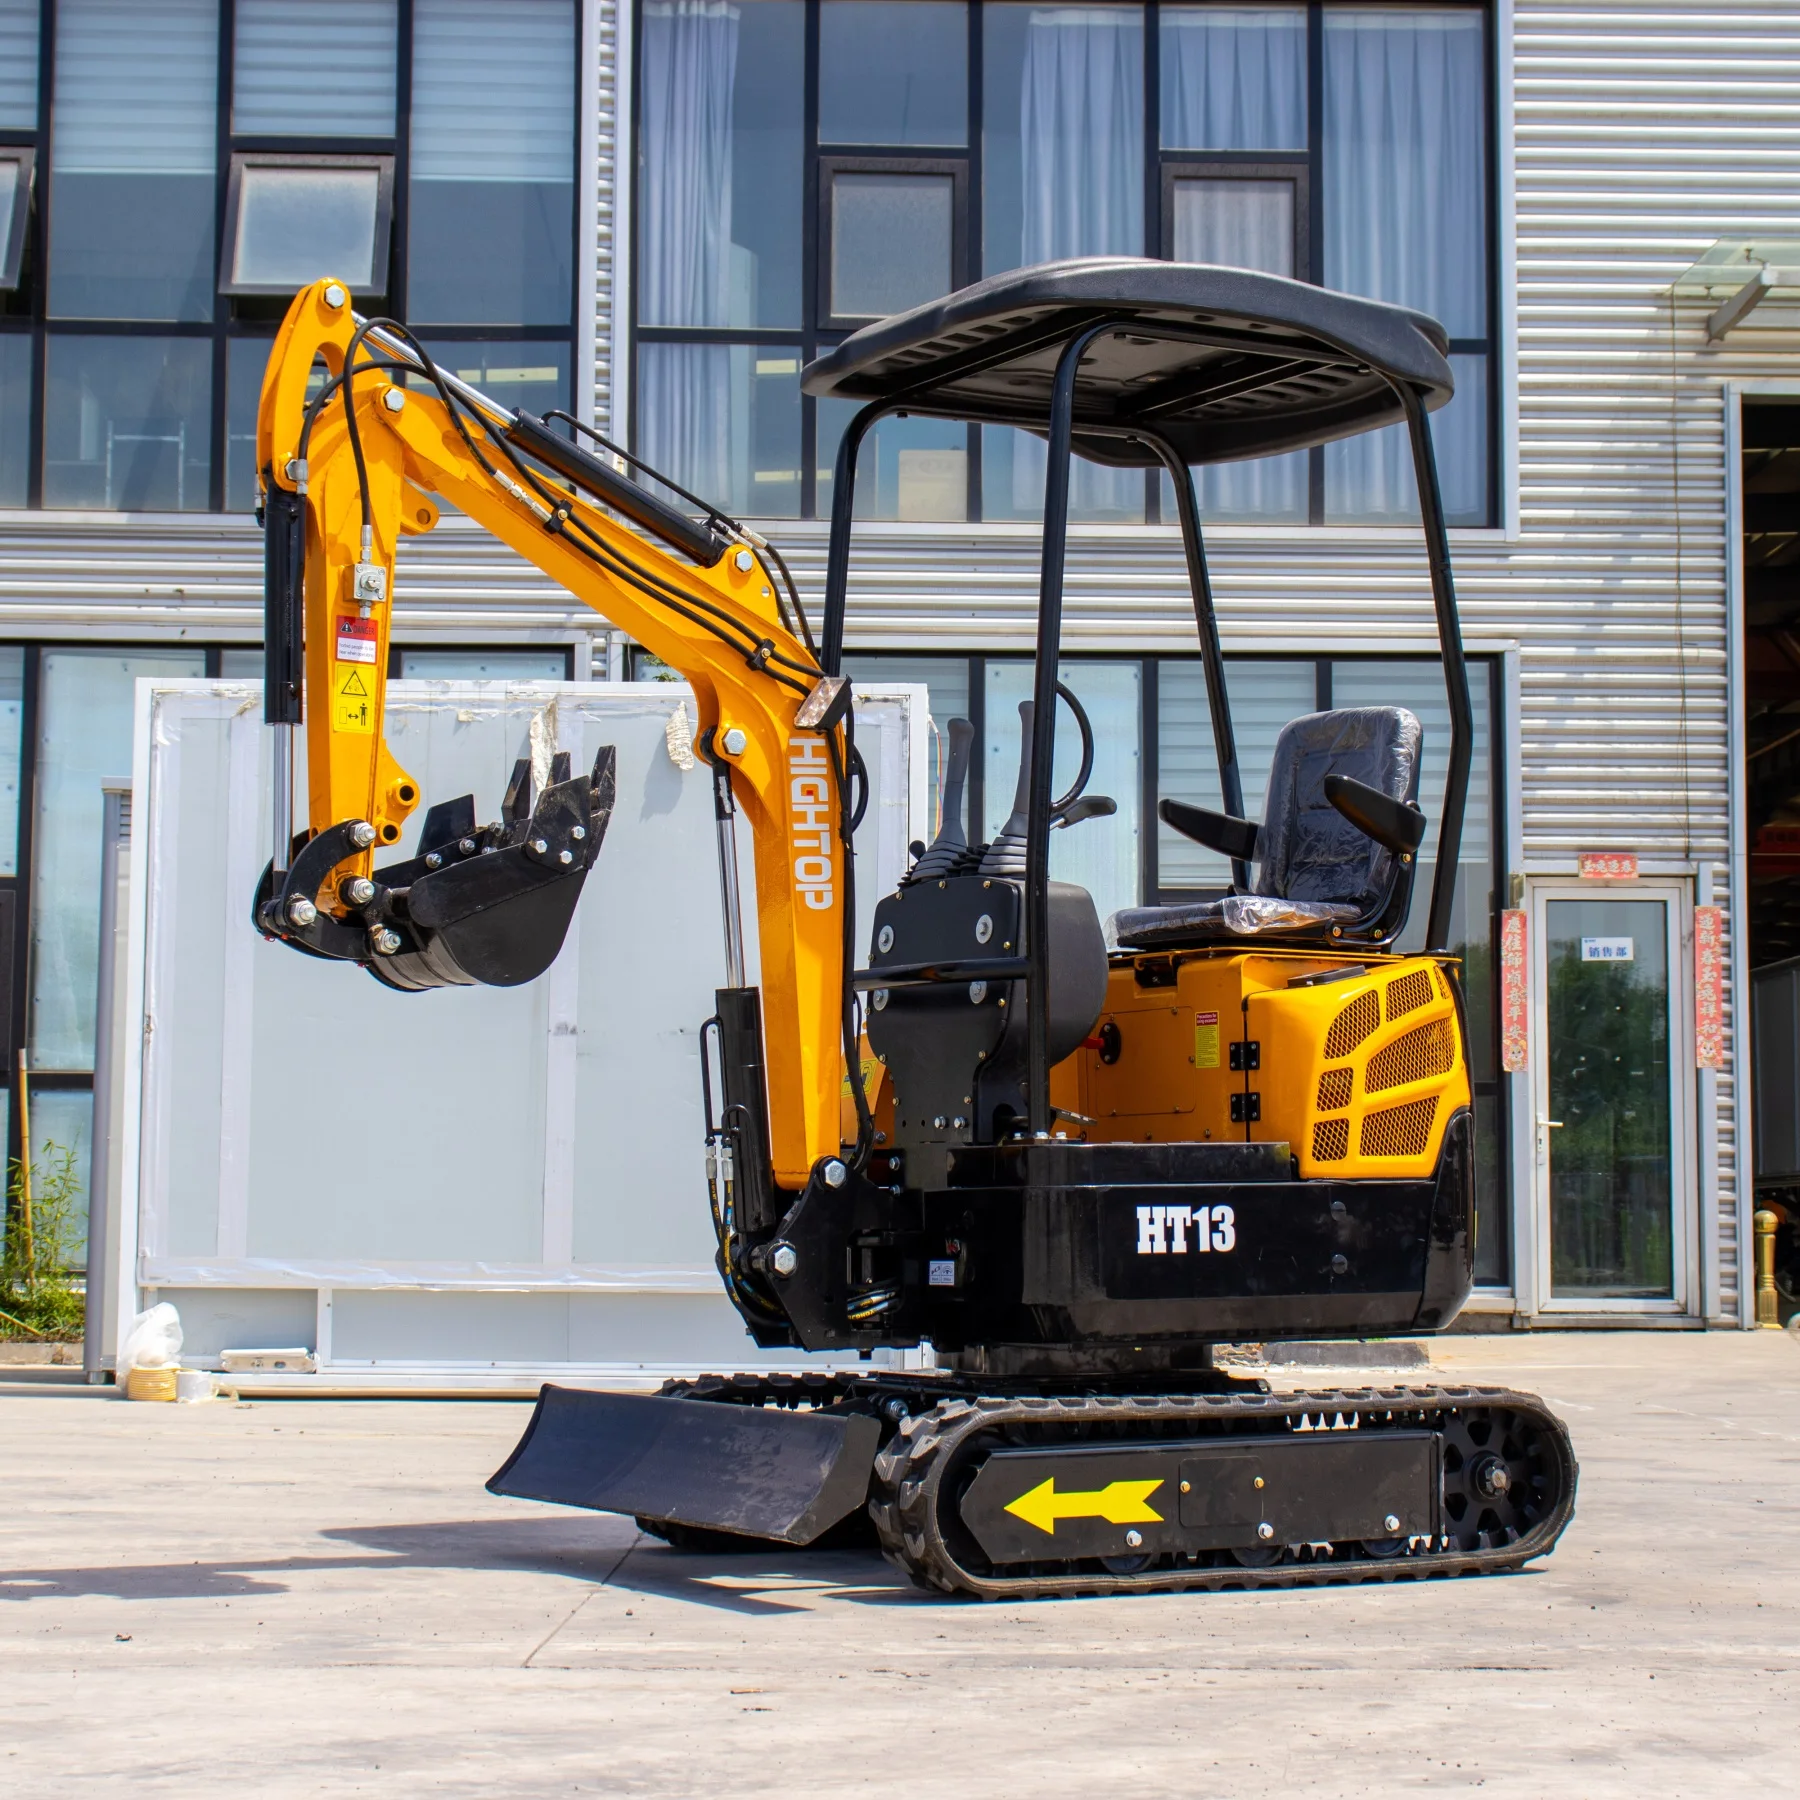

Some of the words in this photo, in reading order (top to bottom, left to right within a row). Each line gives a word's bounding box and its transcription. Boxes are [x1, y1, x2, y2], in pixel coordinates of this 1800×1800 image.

[353, 625, 375, 635] DANGER
[789, 738, 833, 910] HIGHTOP
[1136, 1205, 1236, 1254] HT13
